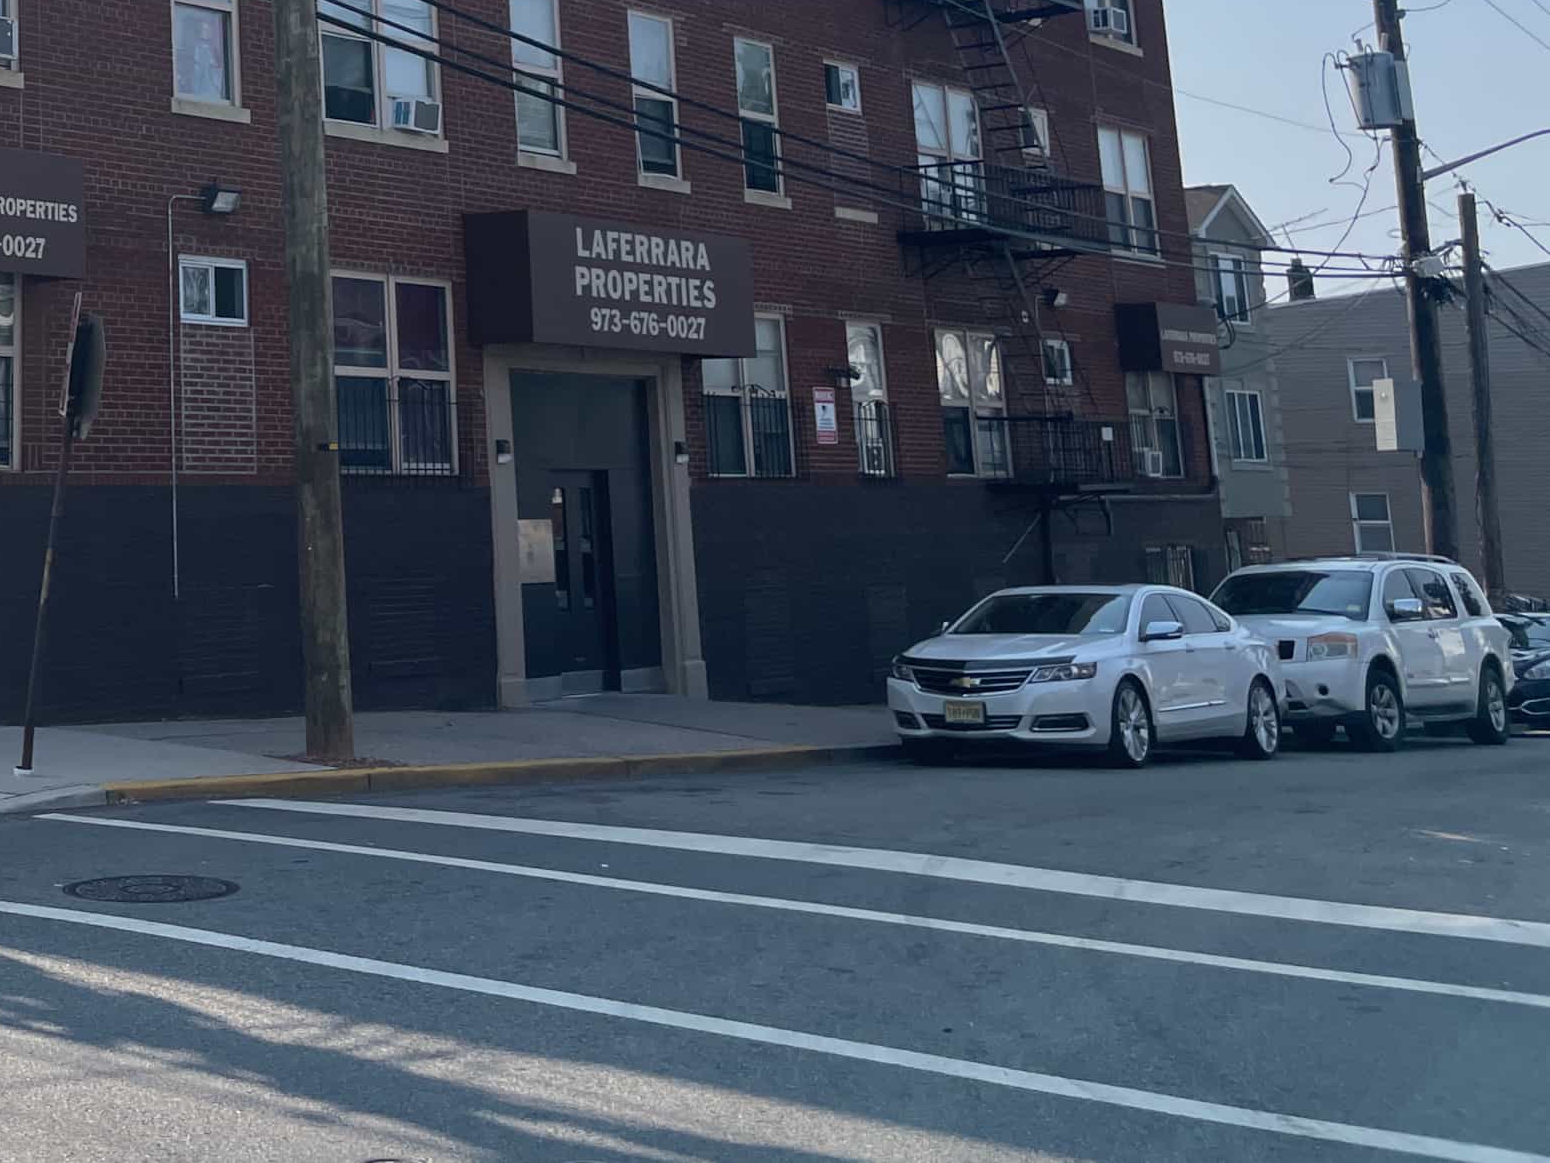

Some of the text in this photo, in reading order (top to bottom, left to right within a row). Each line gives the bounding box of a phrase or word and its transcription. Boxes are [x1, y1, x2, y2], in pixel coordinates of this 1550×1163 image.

[575, 226, 711, 271] LAFERRARA
[574, 265, 717, 309] PROPERTIES
[590, 306, 706, 340] 973-676-0027
